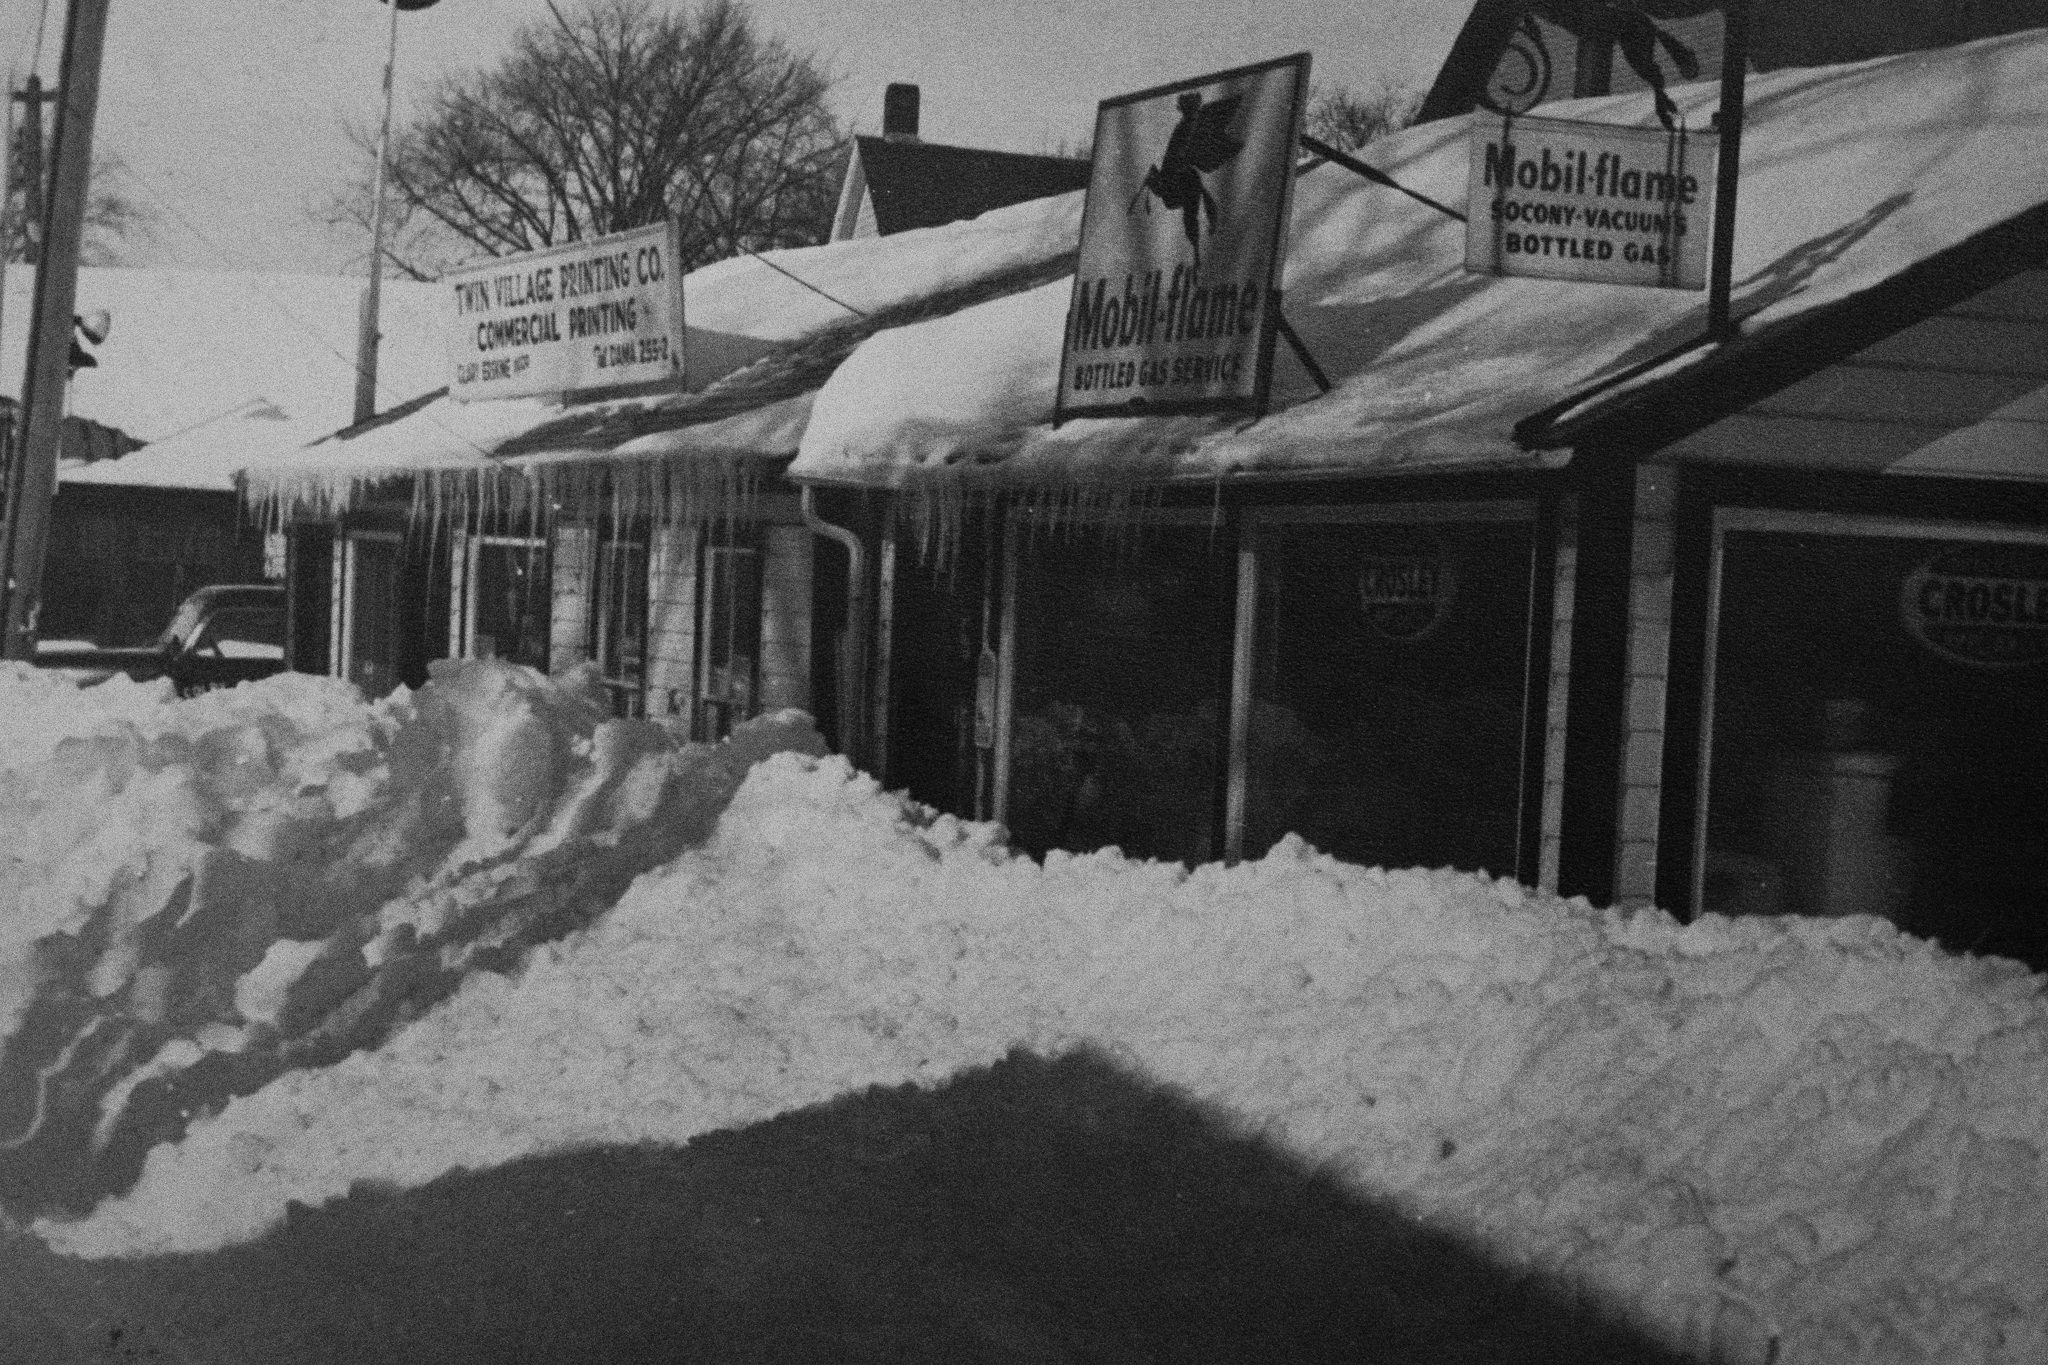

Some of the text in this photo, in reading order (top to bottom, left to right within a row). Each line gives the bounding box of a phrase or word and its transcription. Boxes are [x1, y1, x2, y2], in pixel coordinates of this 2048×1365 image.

[1506, 232, 1671, 267] BOTTLED GAS
[455, 246, 666, 315] TWIN VILLAGE PRINTING CO.
[477, 297, 637, 351] COMMERCIAL PRINTING
[1073, 353, 1243, 391] BOTTLED GAS SERVICE
